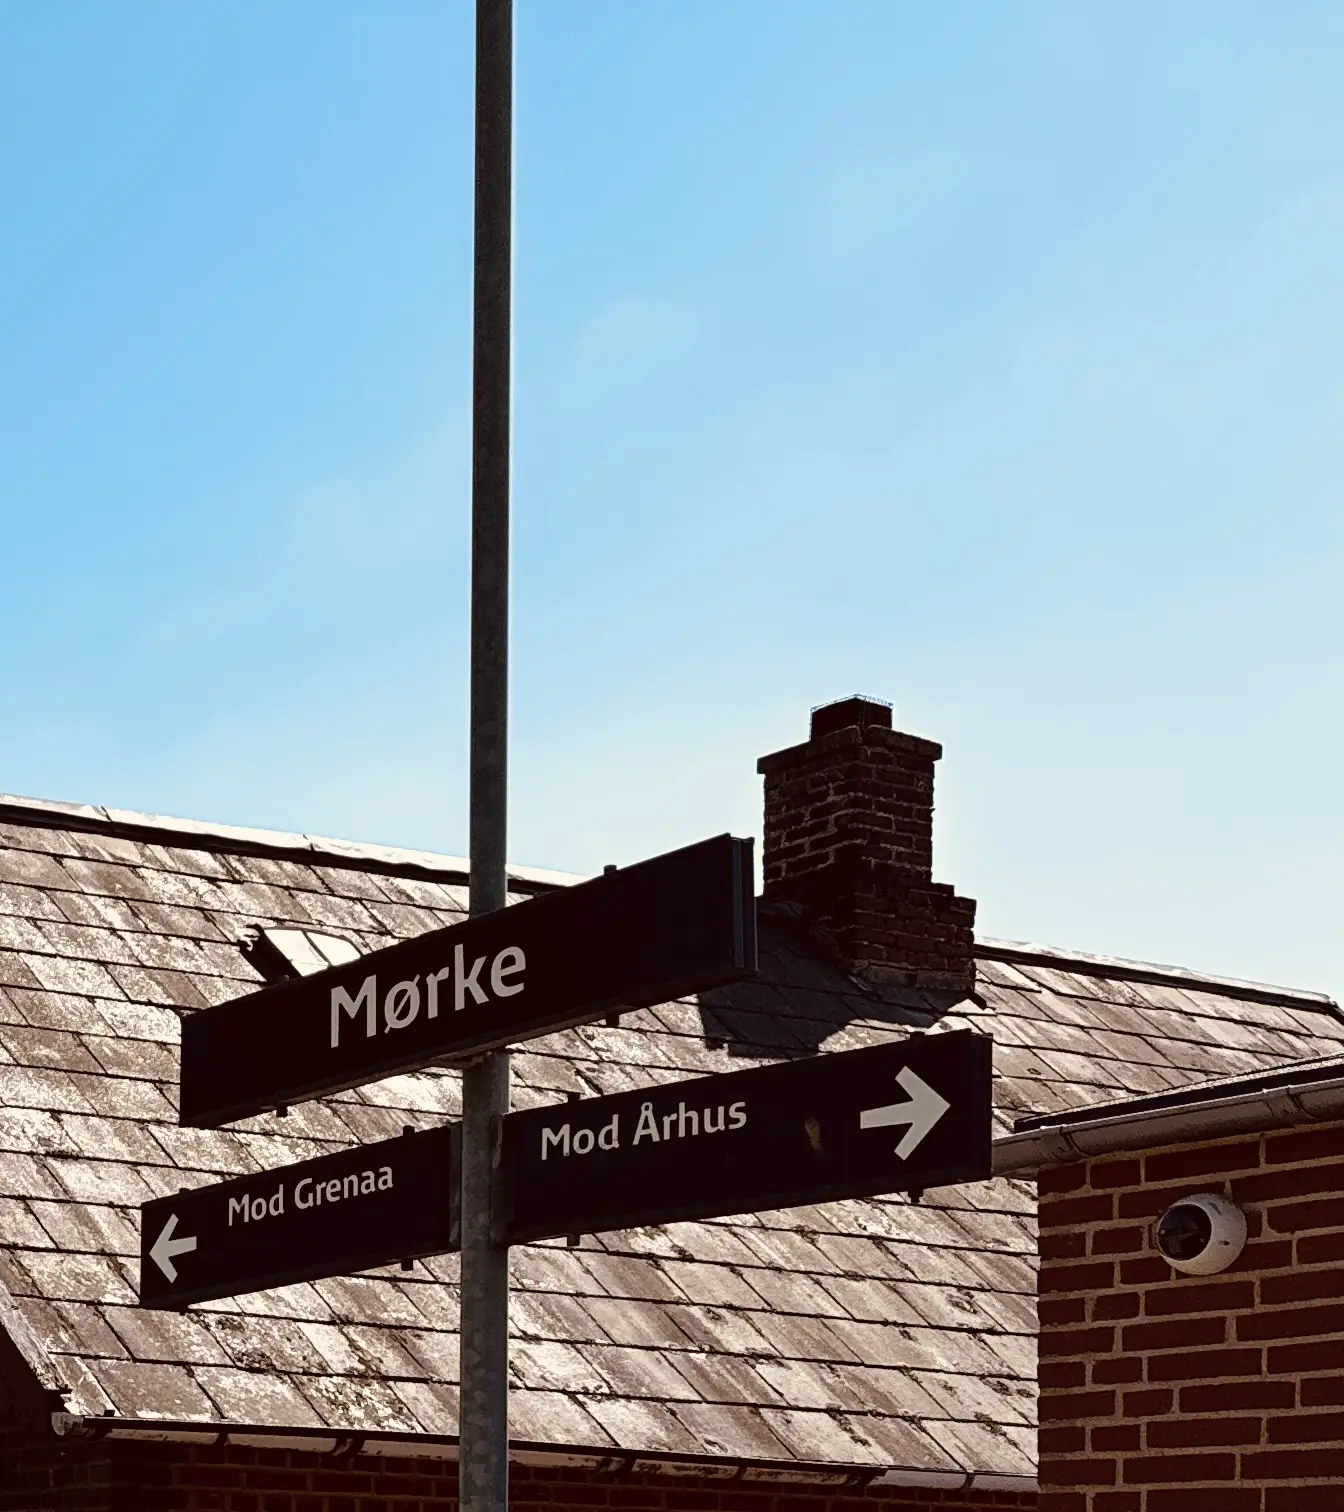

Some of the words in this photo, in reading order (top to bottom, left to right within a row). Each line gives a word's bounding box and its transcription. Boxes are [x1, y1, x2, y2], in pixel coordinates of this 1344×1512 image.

[330, 943, 527, 1049] Mørke
[541, 1113, 621, 1162] Mod
[632, 1100, 748, 1147] Århus
[227, 1183, 285, 1227] Mod
[294, 1166, 394, 1210] Grenaa
